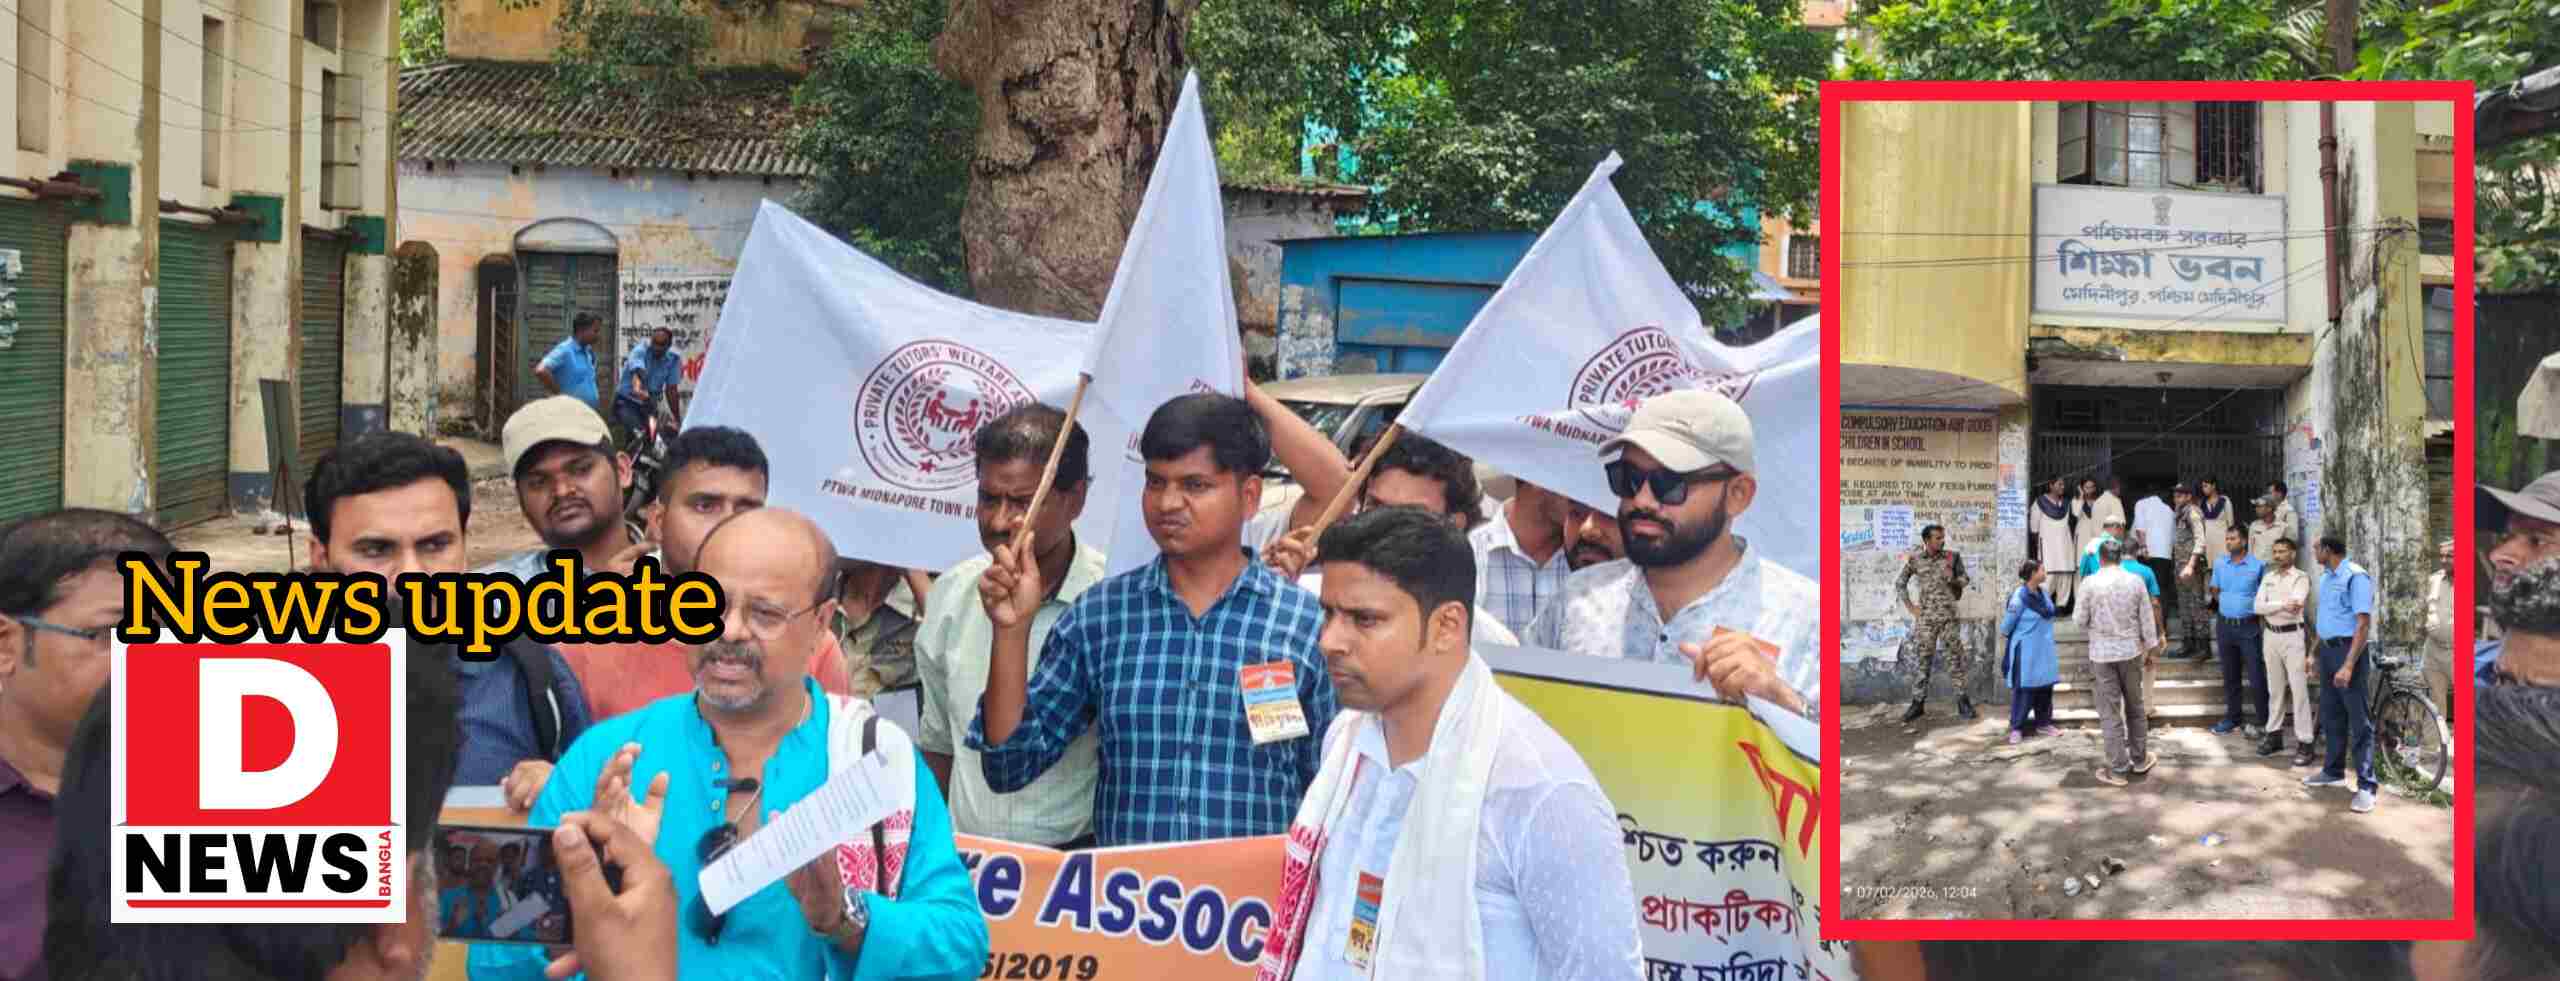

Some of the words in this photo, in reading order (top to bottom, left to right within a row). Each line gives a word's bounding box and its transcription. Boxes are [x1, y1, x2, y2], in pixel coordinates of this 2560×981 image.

[2081, 220, 2170, 242] পশ্চিমবঙ্গ
[2178, 226, 2248, 248] সরকার
[2057, 239, 2154, 278] শিক্ষা
[2168, 254, 2265, 282] ভবন
[2148, 285, 2193, 304] পশ্চিম
[864, 374, 892, 428] PRIVATE
[949, 347, 1011, 388] WELFARE
[1579, 349, 1626, 404] PRIVATE
[1899, 416, 1947, 431] EDUCATION
[1892, 435, 1927, 452] SCHOOL
[822, 479, 857, 498] PTWA
[860, 487, 928, 511] MIDNAPORE
[930, 498, 962, 517] TOWN
[1694, 839, 1781, 873] করুন
